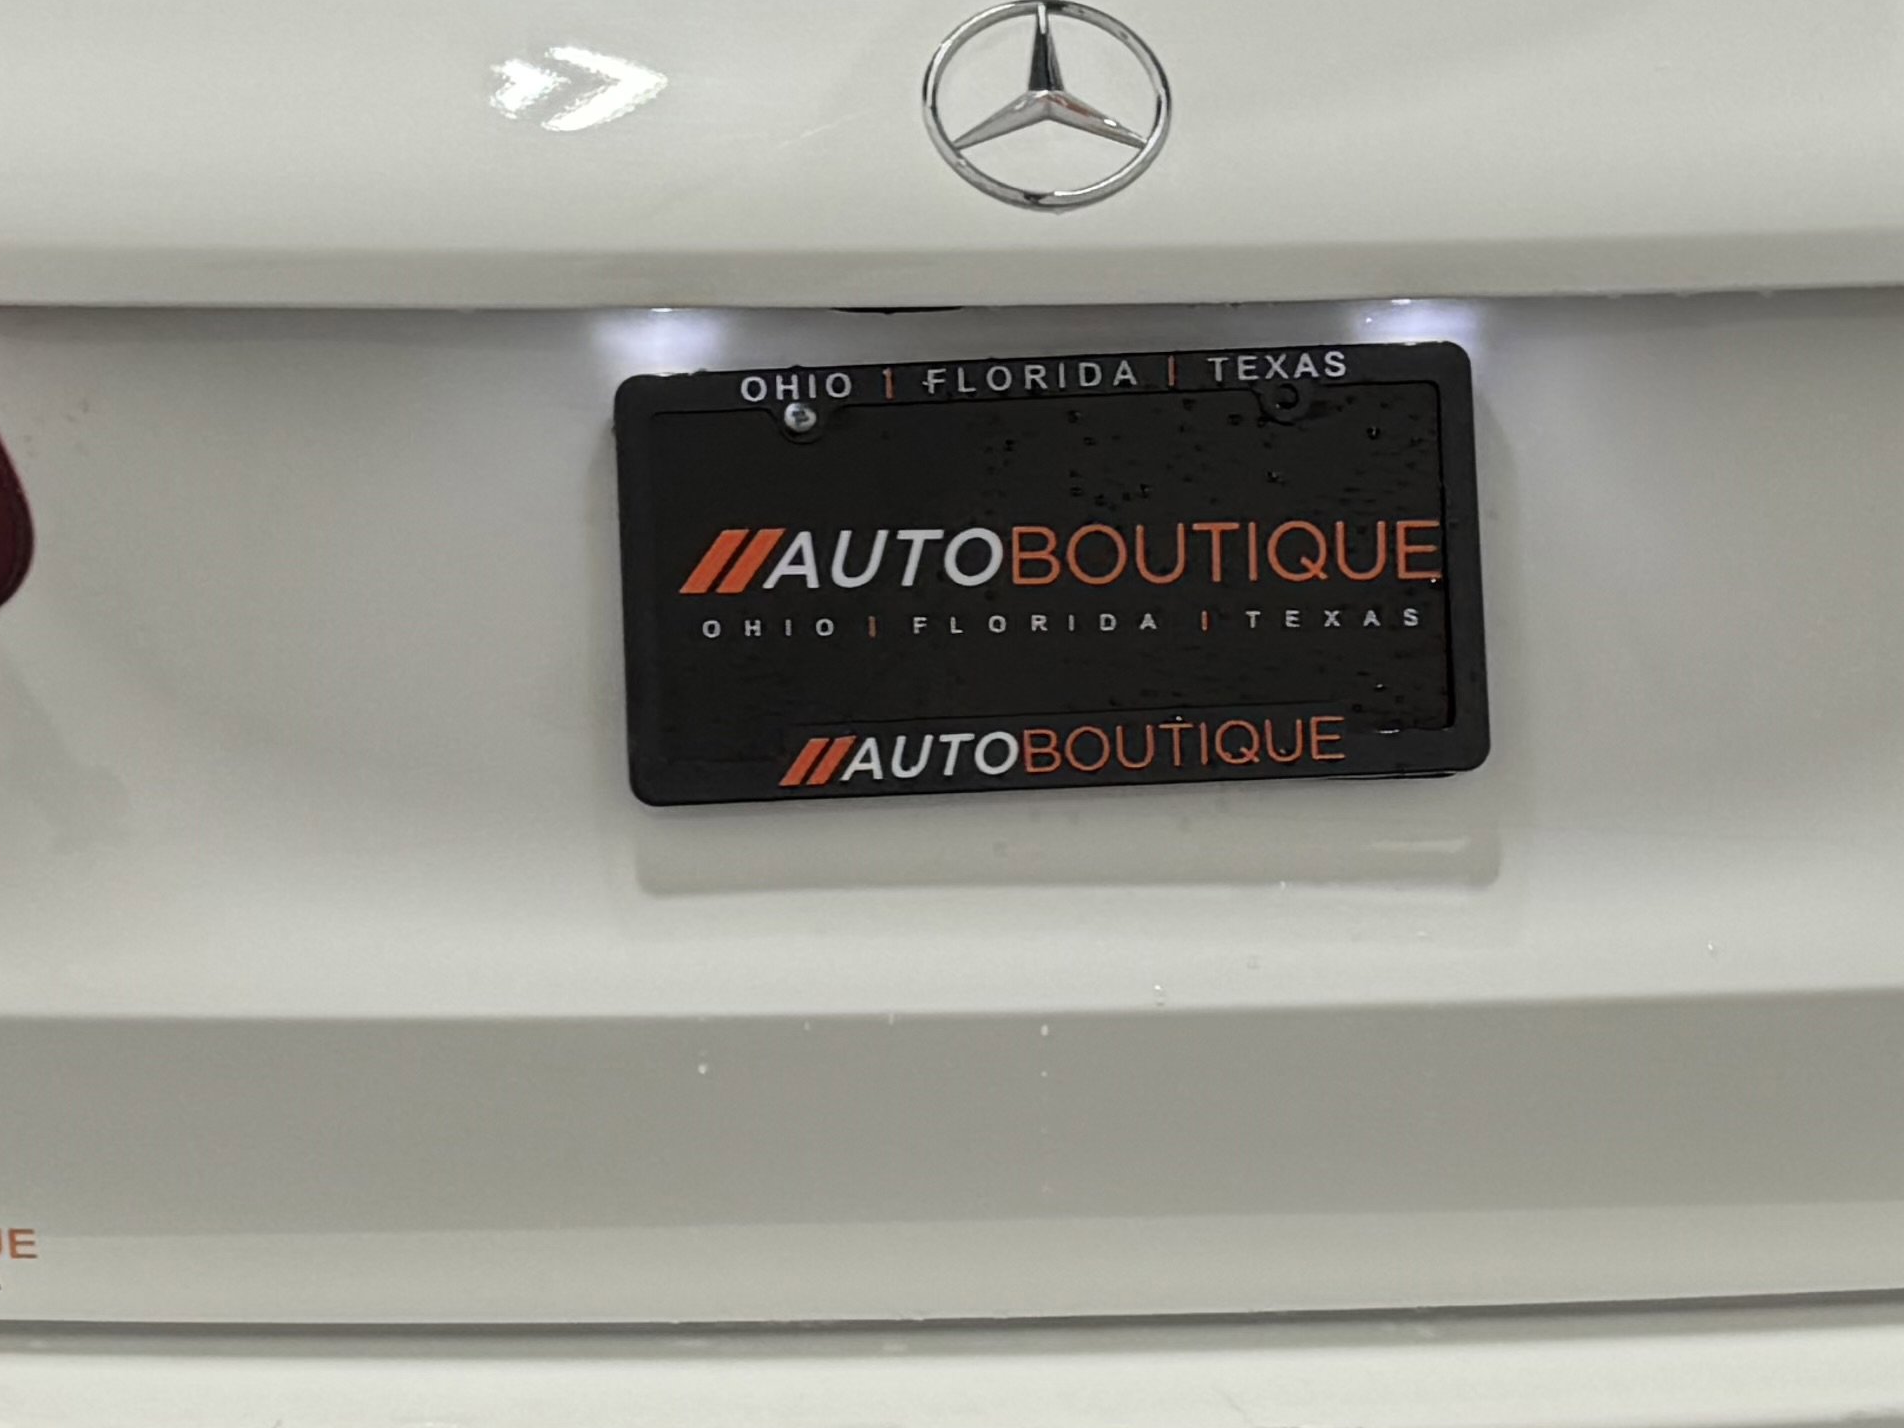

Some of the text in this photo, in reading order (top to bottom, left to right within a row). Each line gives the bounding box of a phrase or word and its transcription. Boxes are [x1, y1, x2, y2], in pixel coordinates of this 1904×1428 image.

[739, 349, 1348, 403] OHIO FLORIDA TEXAS
[701, 607, 1419, 639] OHIO FLORIDA TEXAS
